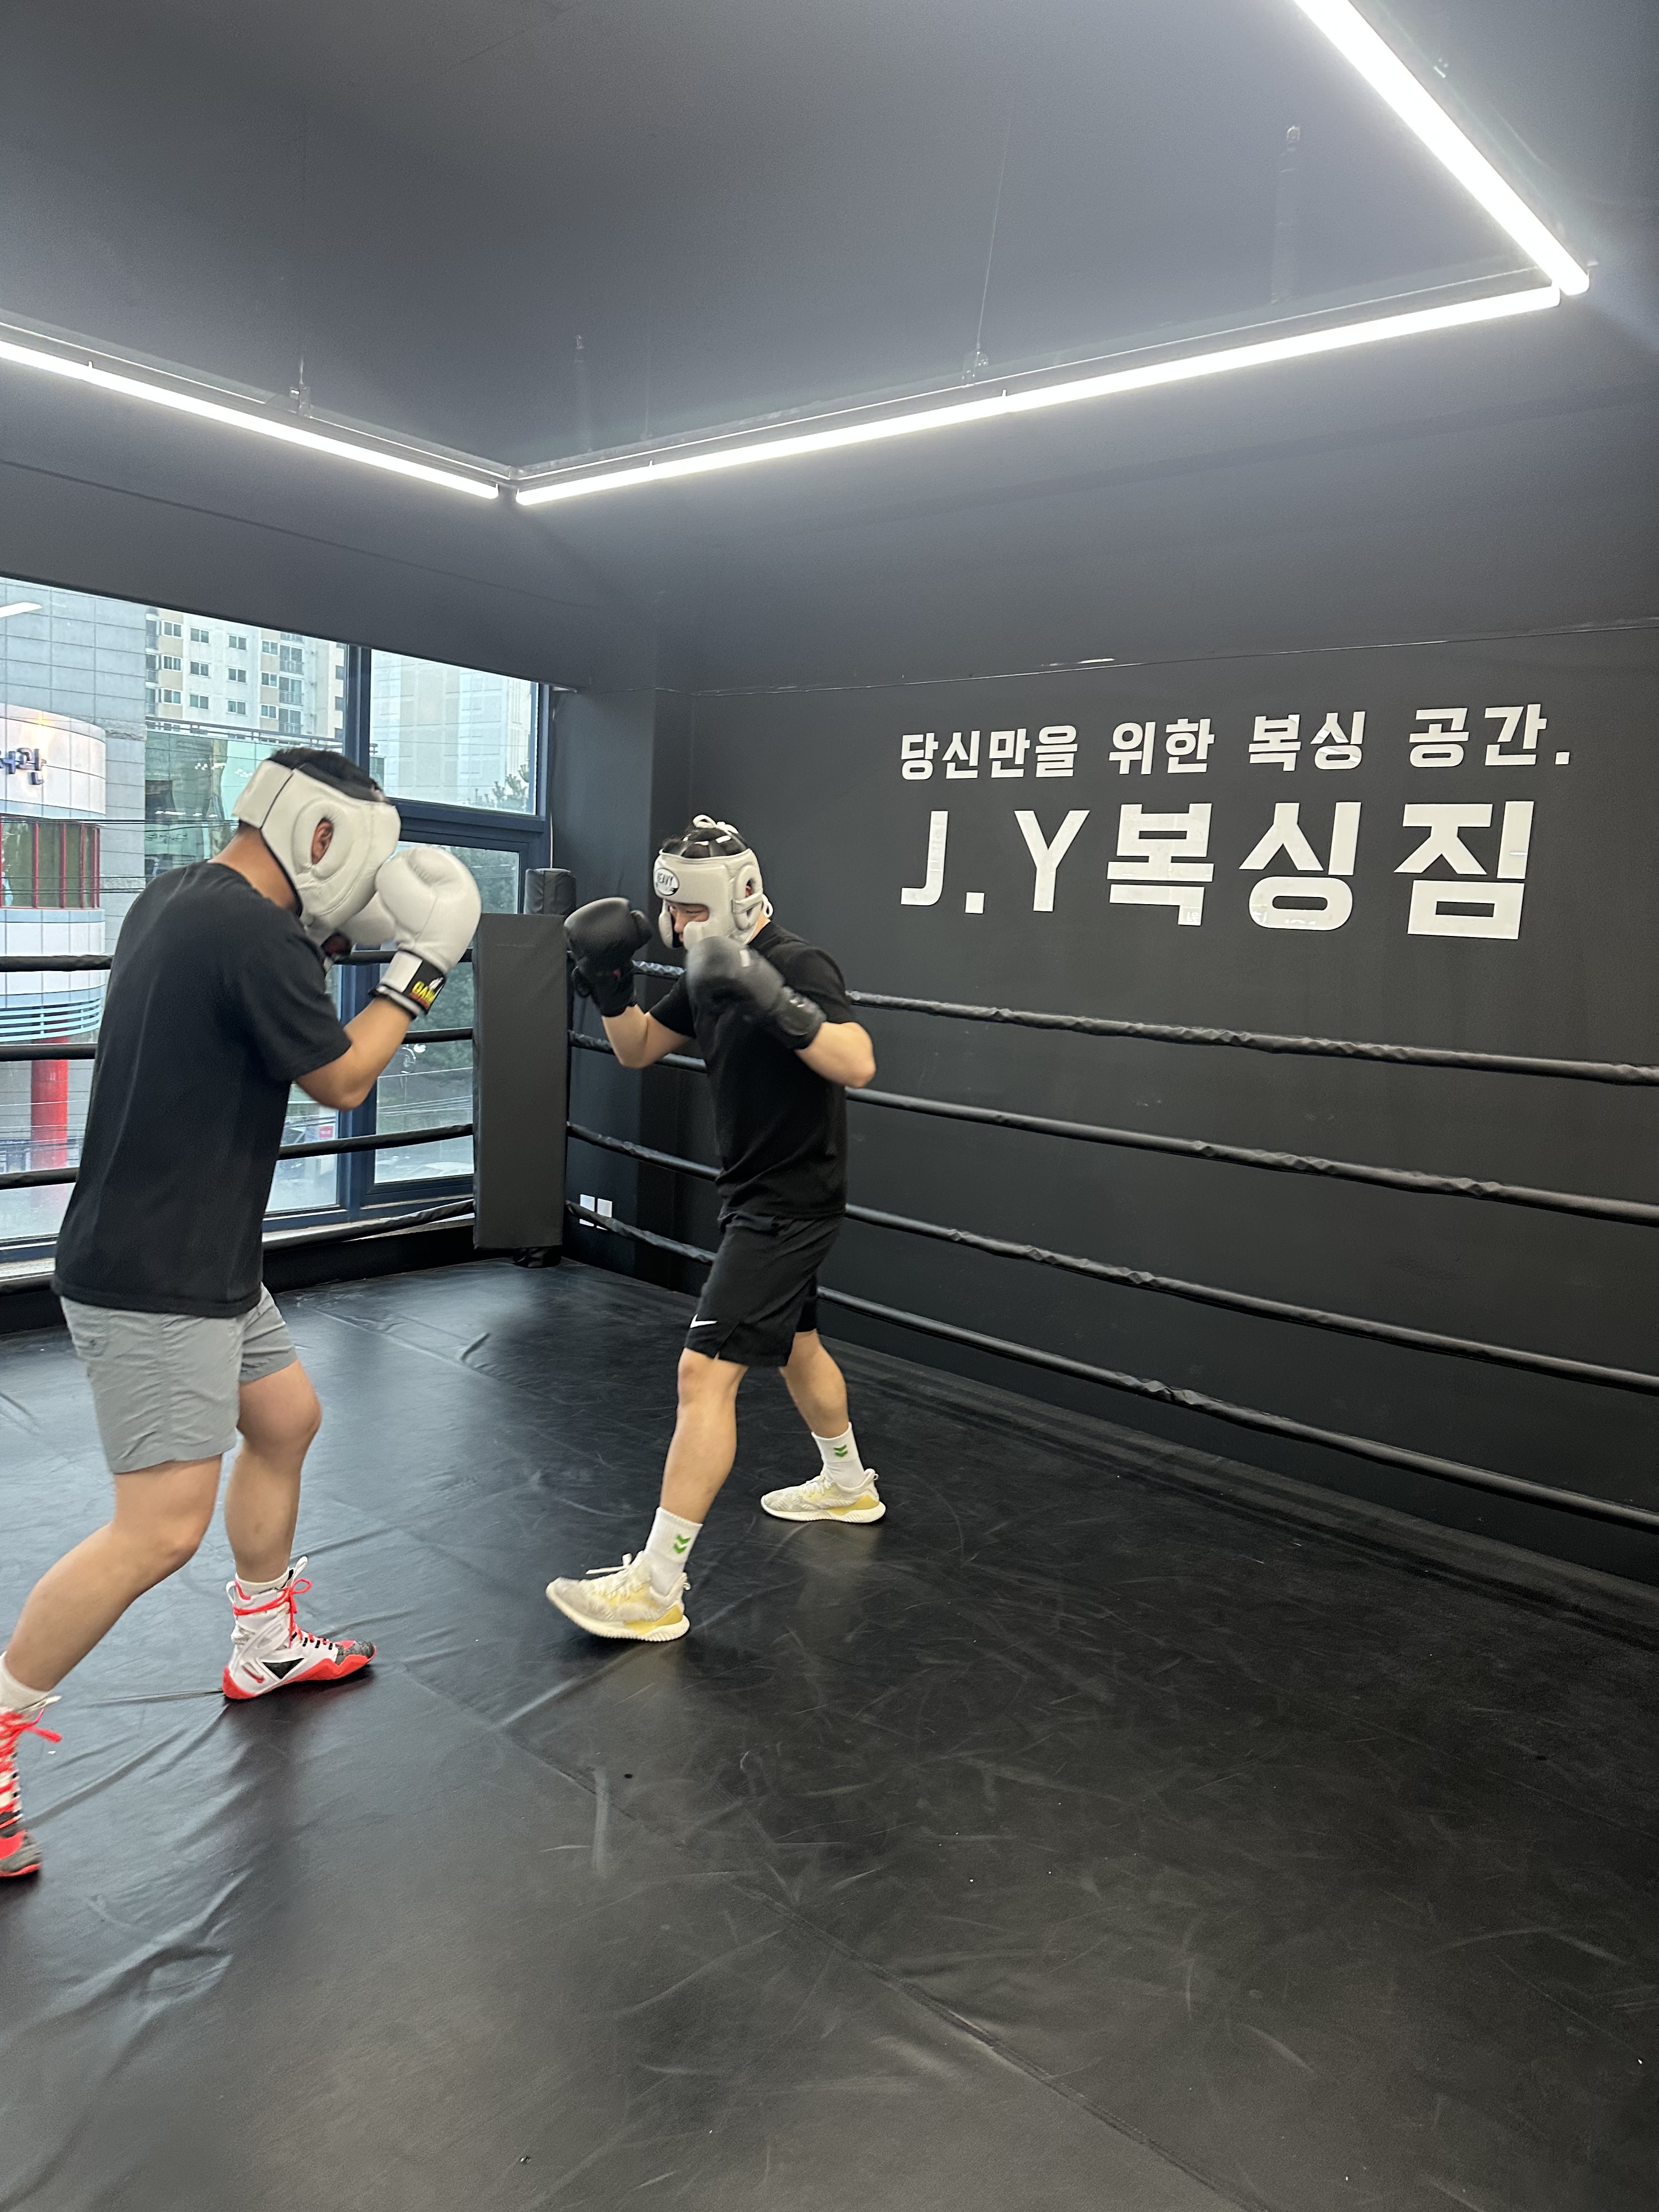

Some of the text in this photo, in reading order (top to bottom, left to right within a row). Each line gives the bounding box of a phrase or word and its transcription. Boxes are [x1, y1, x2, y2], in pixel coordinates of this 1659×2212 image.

[901, 703, 1570, 780] 당신만을 위한 복싱 공간.
